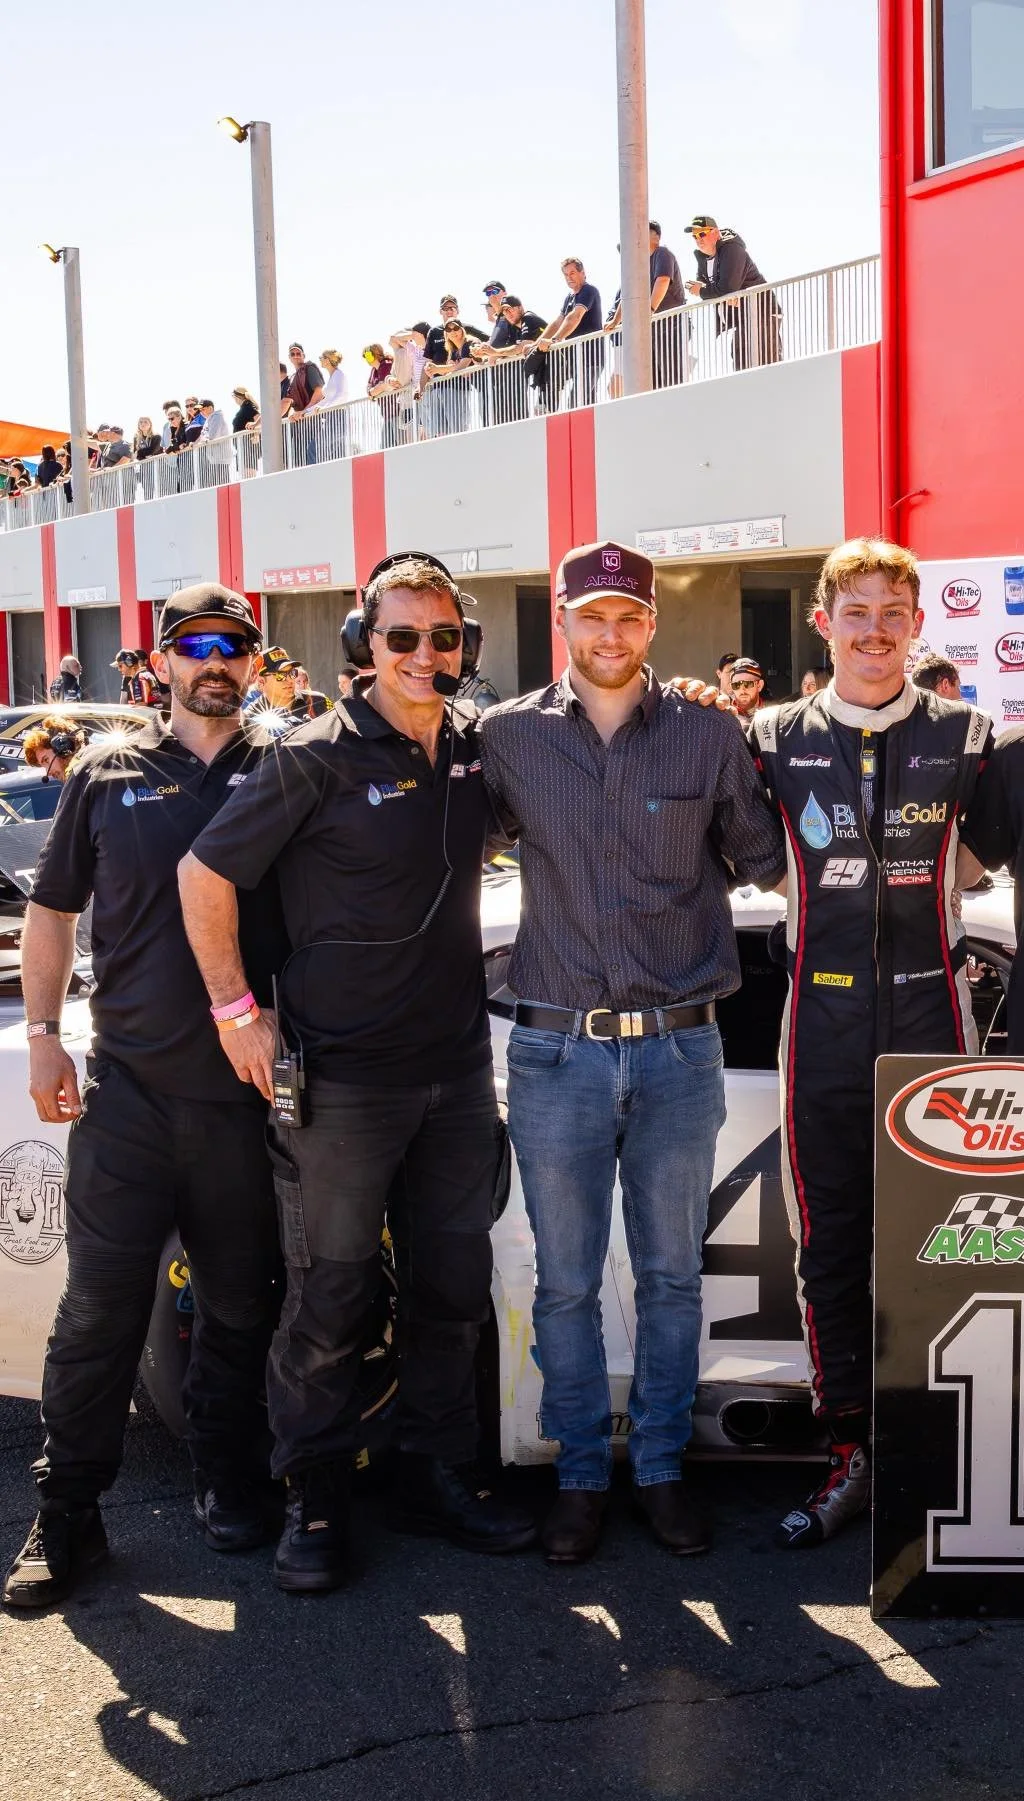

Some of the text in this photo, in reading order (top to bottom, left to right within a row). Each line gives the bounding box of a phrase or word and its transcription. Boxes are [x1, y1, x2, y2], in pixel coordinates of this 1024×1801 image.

[585, 575, 639, 589] ARIAT
[955, 586, 979, 596] Hi-Tec
[955, 597, 969, 607] Oils
[945, 644, 977, 653] Engineered
[948, 651, 978, 659] To Perform
[1009, 652, 1023, 661] Oils
[1004, 706, 1012, 714] To
[820, 858, 868, 888] 29
[886, 867, 930, 876] HERNE
[888, 875, 932, 885] RACING
[817, 973, 849, 986] Sabelt
